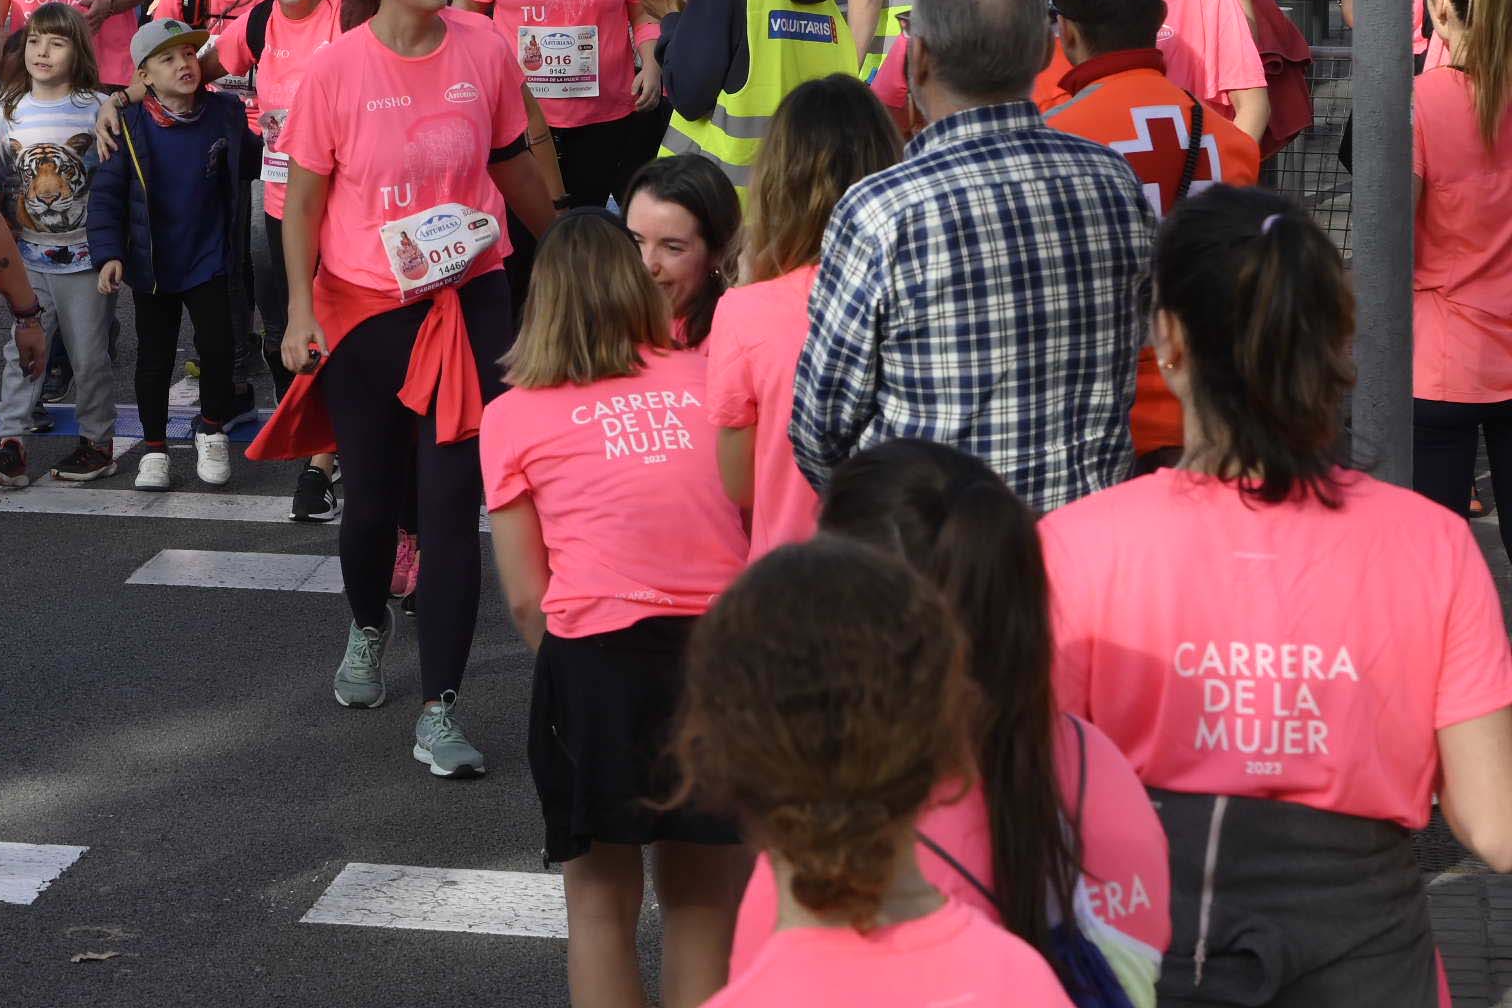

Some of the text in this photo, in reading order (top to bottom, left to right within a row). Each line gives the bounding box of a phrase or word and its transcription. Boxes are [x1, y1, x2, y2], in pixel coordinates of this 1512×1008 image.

[520, 5, 545, 22] TU
[544, 54, 572, 66] 016
[549, 68, 567, 76] 9142
[367, 95, 412, 112] OYSHO
[380, 182, 413, 210] TU
[419, 219, 459, 238] ASTURIANA
[429, 241, 466, 264] 016
[438, 259, 466, 276] 14460
[571, 390, 702, 425] CARRERA
[601, 409, 684, 438] DE LA
[604, 429, 694, 460] MUJER
[1174, 640, 1360, 682] CARRERA
[1203, 678, 1321, 717] DE LA
[1194, 717, 1329, 756] MUJER
[1245, 761, 1283, 775] 2023
